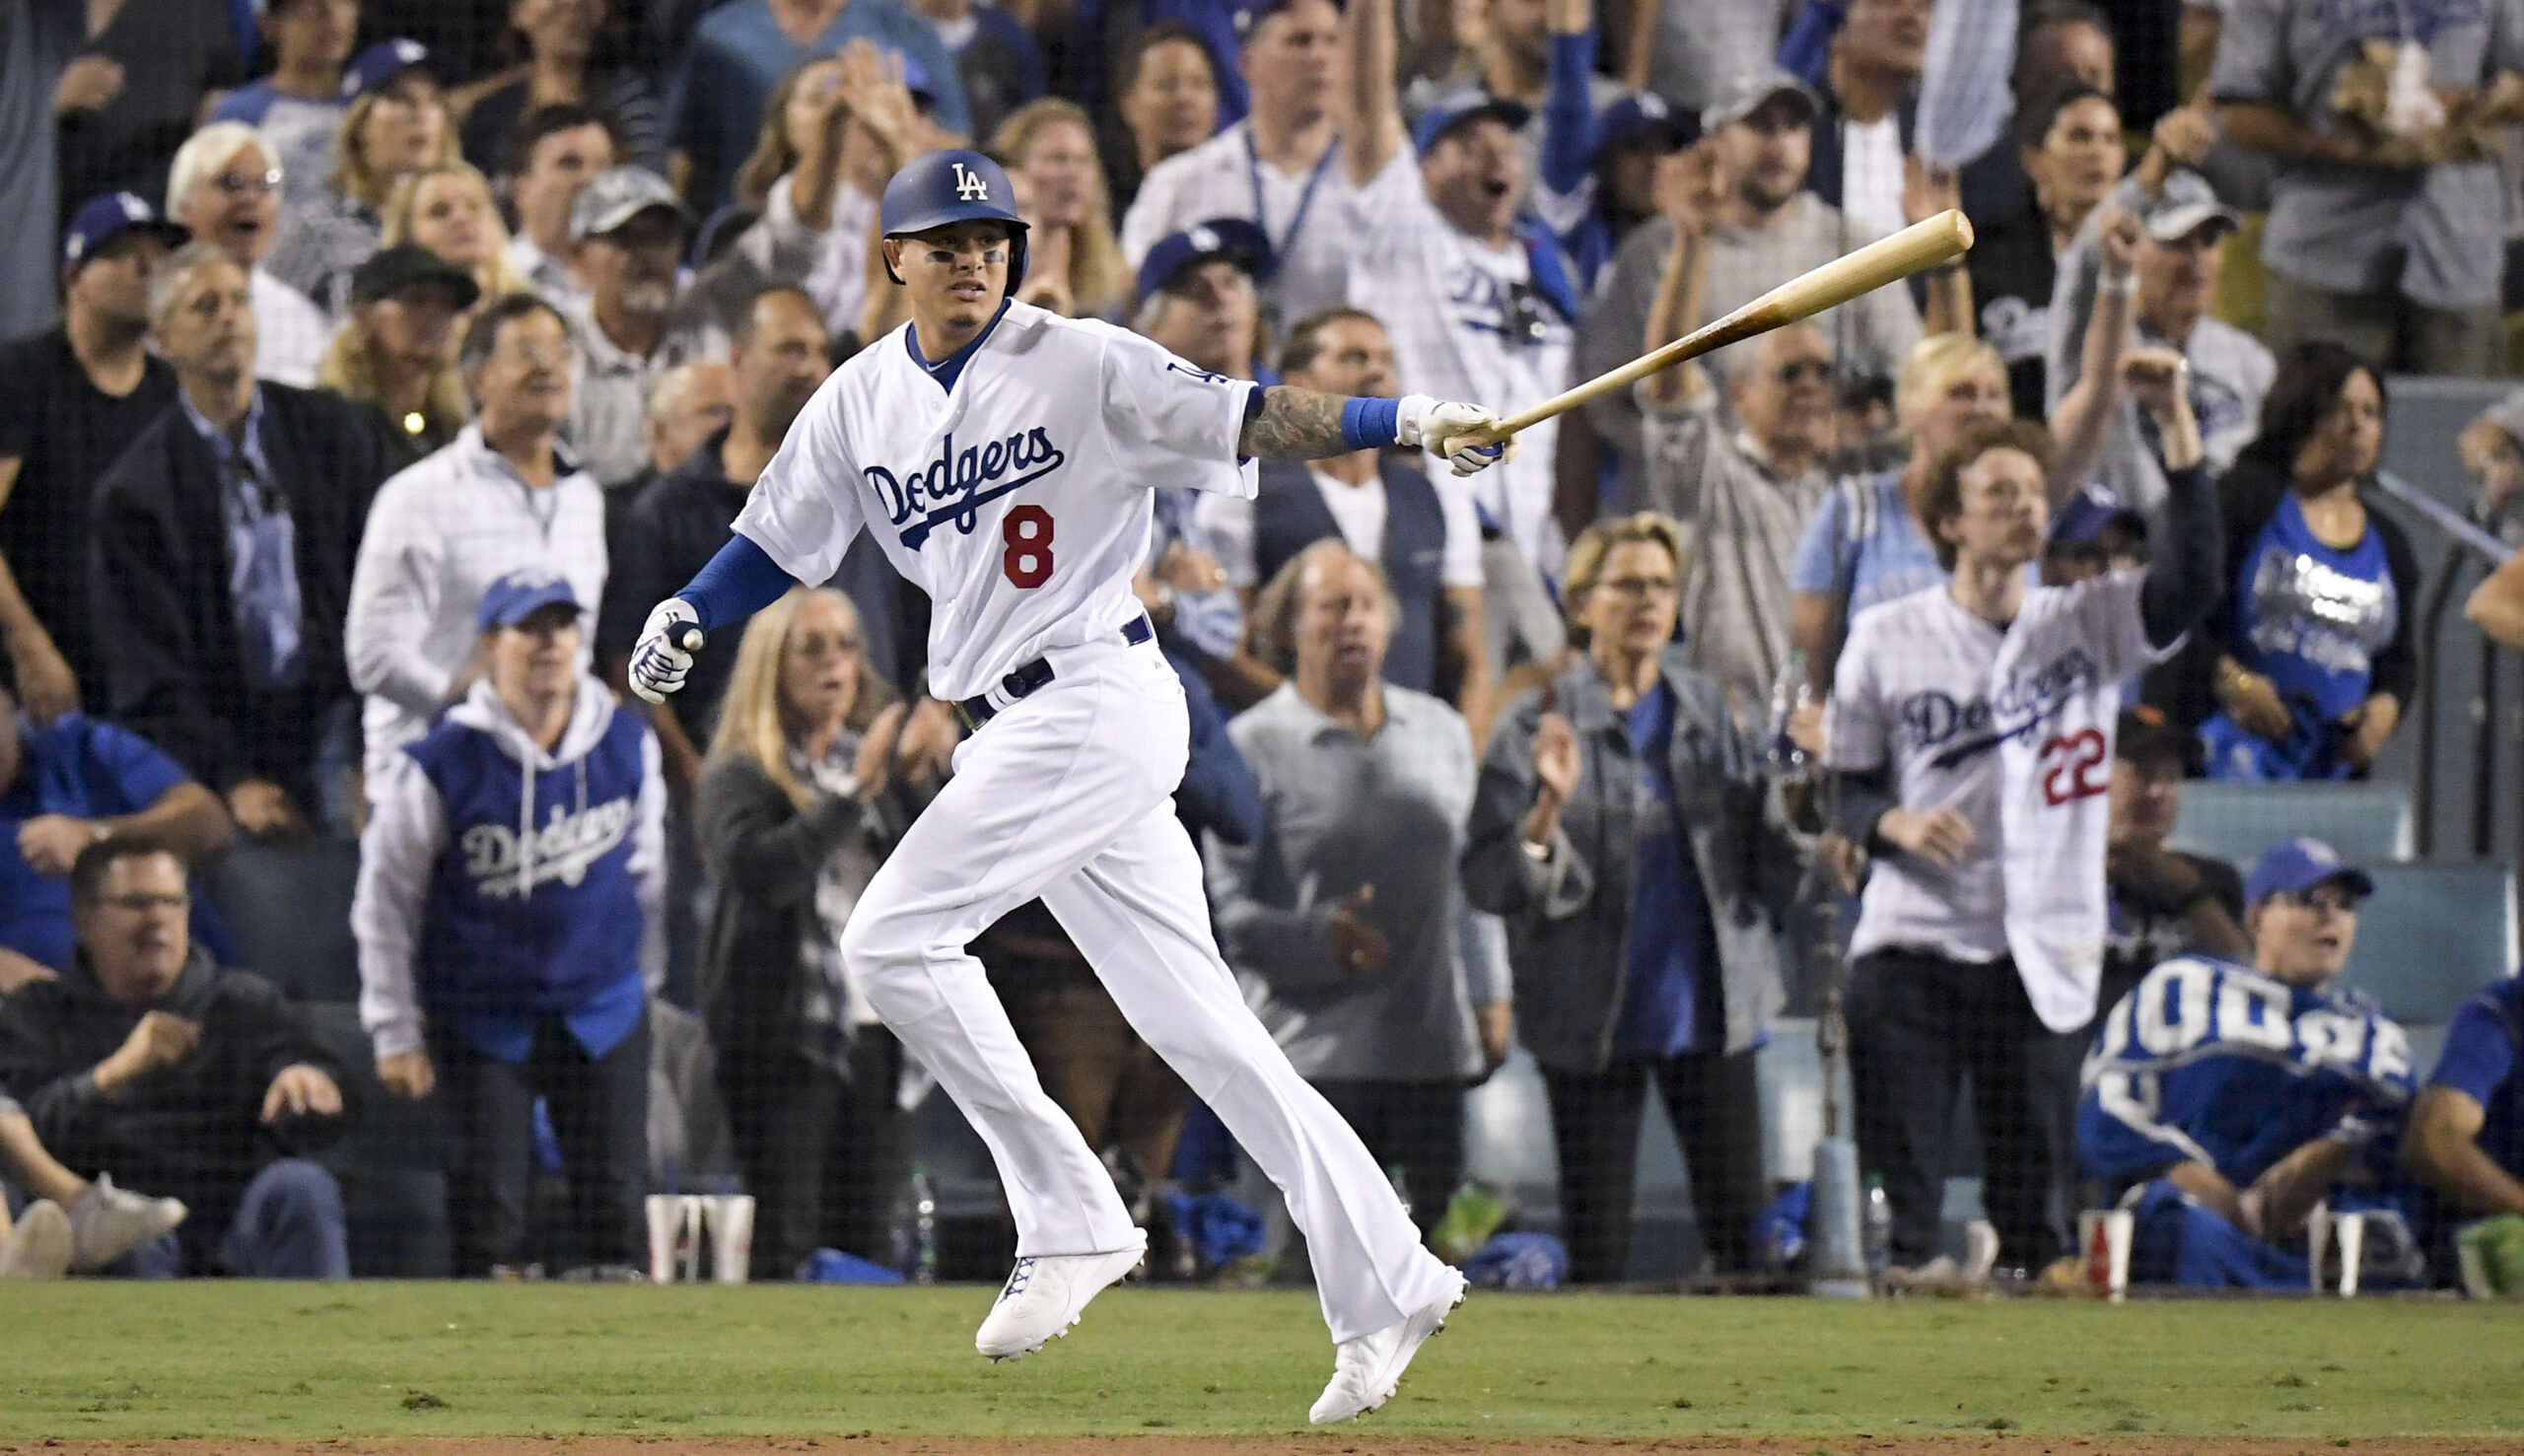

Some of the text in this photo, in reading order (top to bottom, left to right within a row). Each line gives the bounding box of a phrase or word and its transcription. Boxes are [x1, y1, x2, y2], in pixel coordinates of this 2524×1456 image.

[951, 163, 989, 201] LA
[864, 426, 1065, 552] Dodgers
[1002, 504, 1055, 589] 8
[2039, 728, 2108, 806] 22
